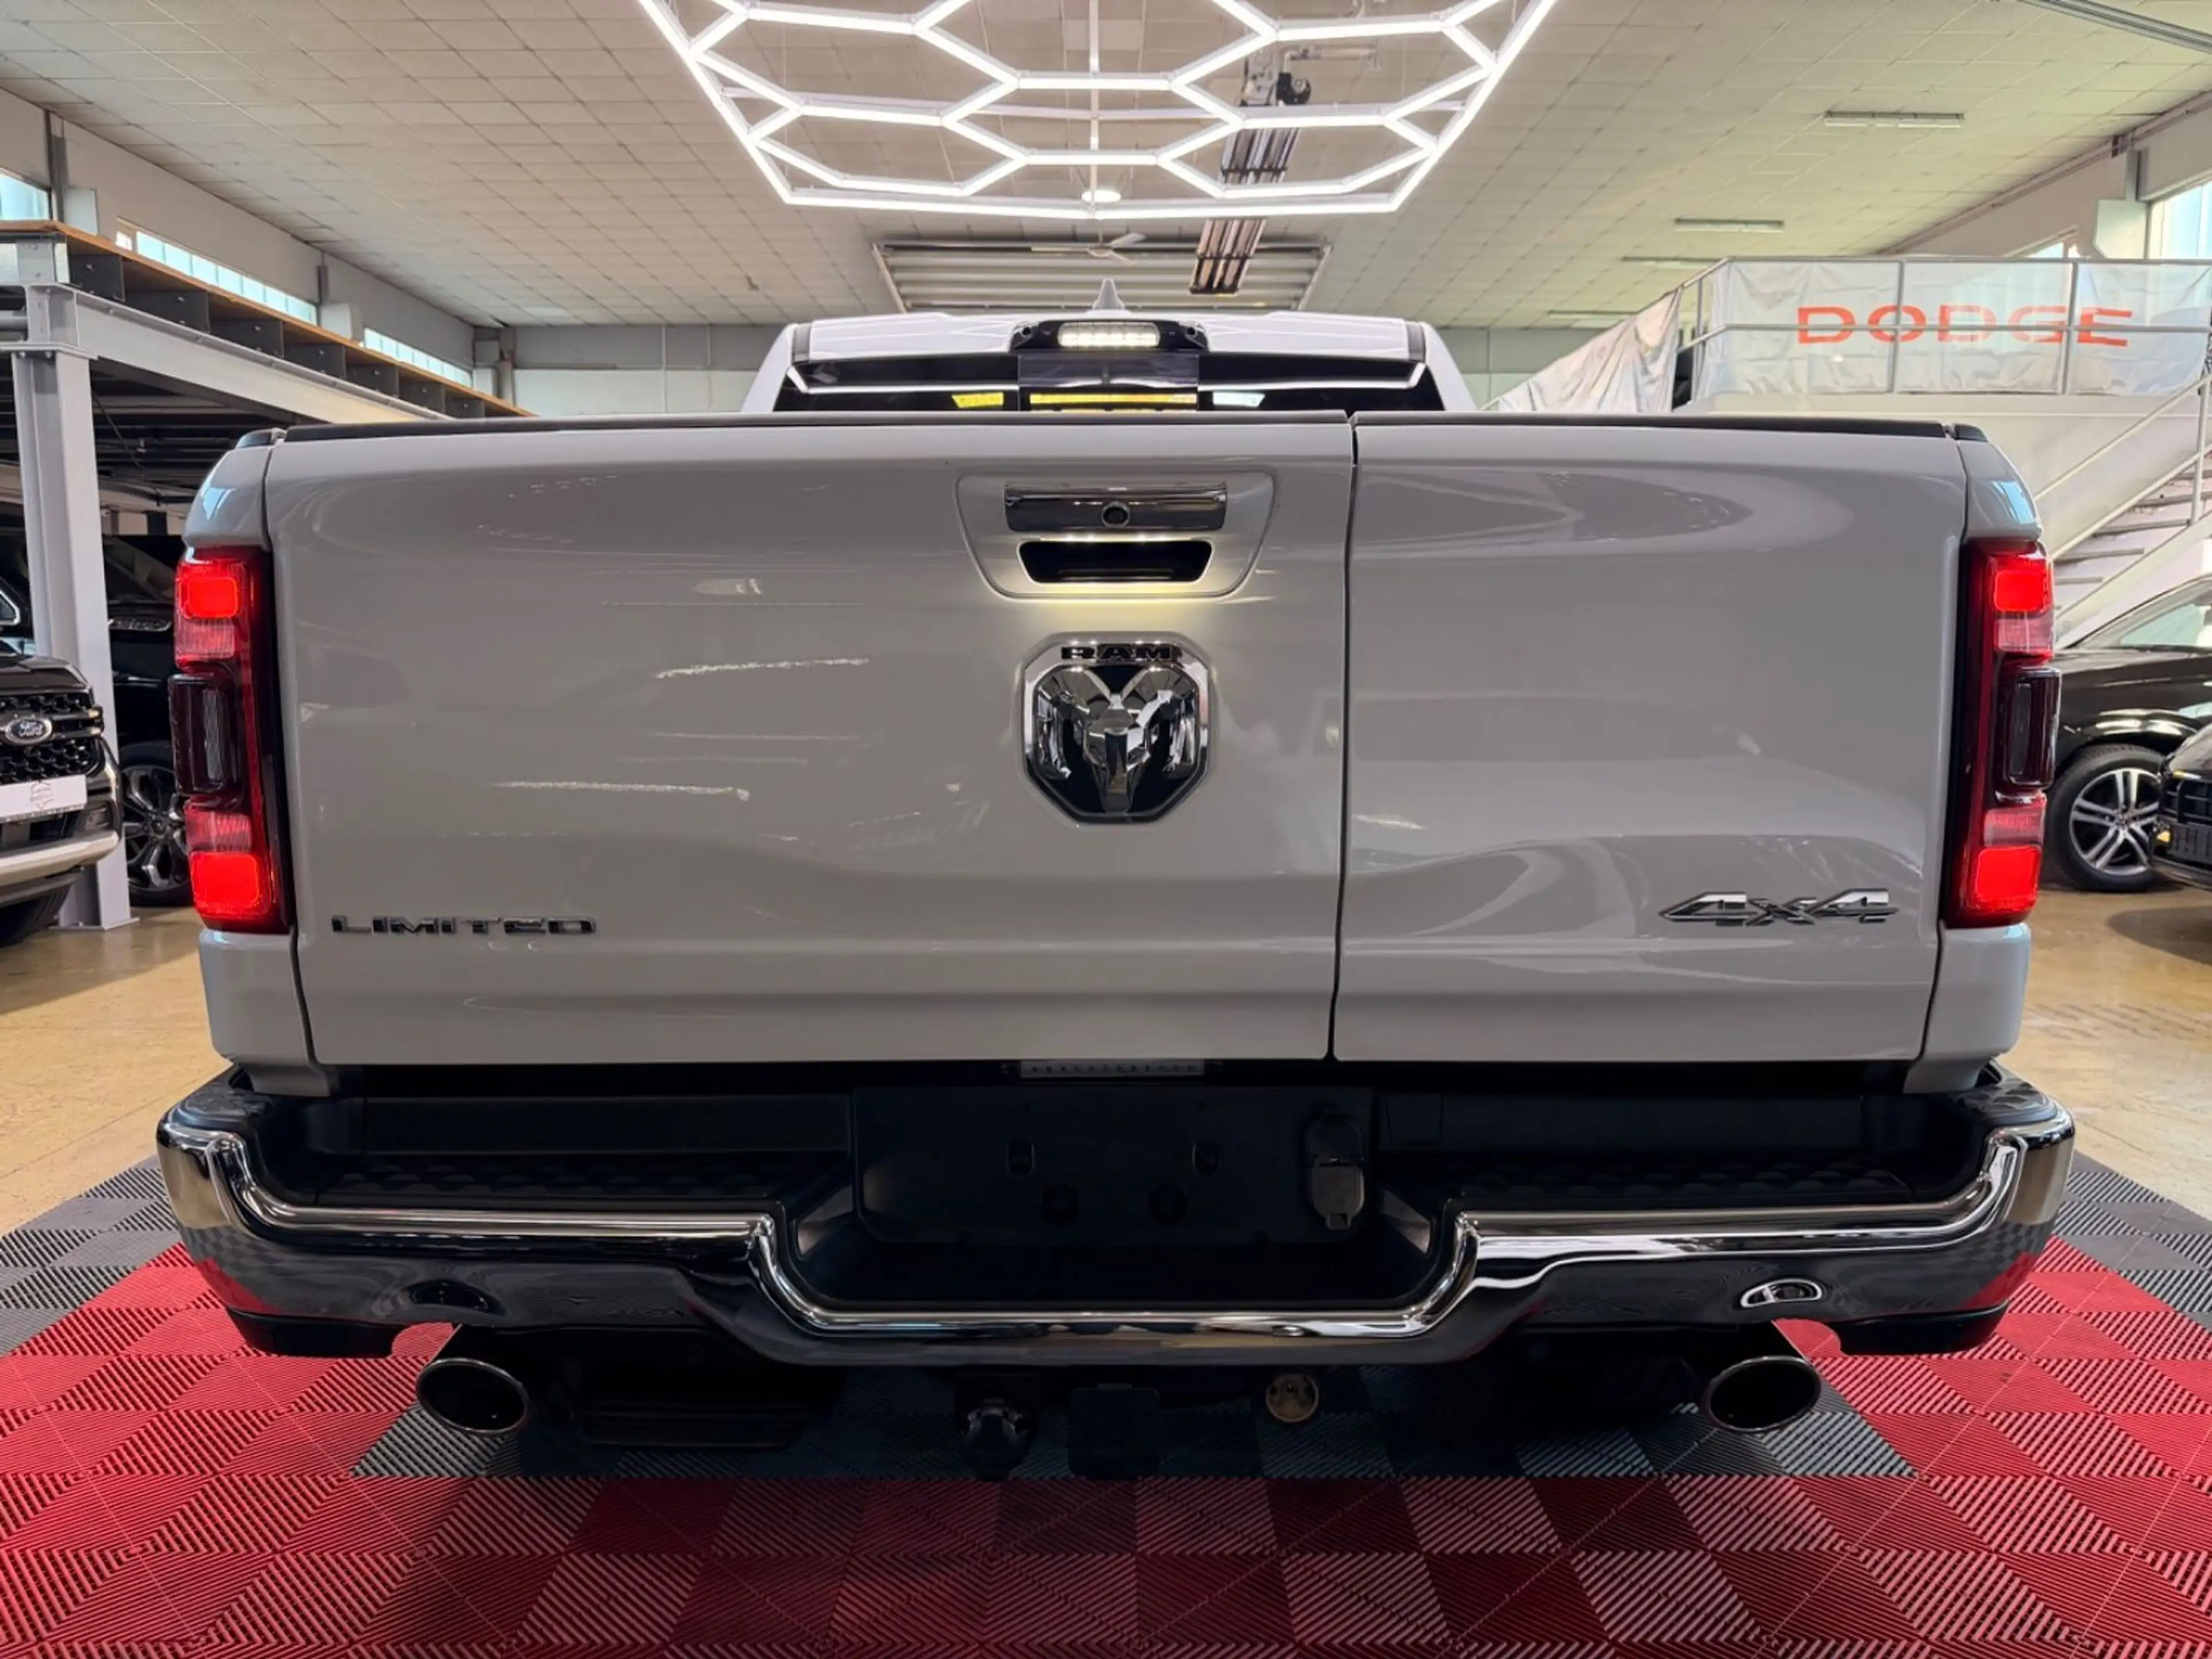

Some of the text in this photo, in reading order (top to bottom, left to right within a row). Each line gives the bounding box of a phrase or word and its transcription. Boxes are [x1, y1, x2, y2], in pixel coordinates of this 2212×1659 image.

[1797, 305, 2132, 346] DODGE
[1060, 644, 1172, 661] RAM
[331, 916, 596, 934] LIMITED
